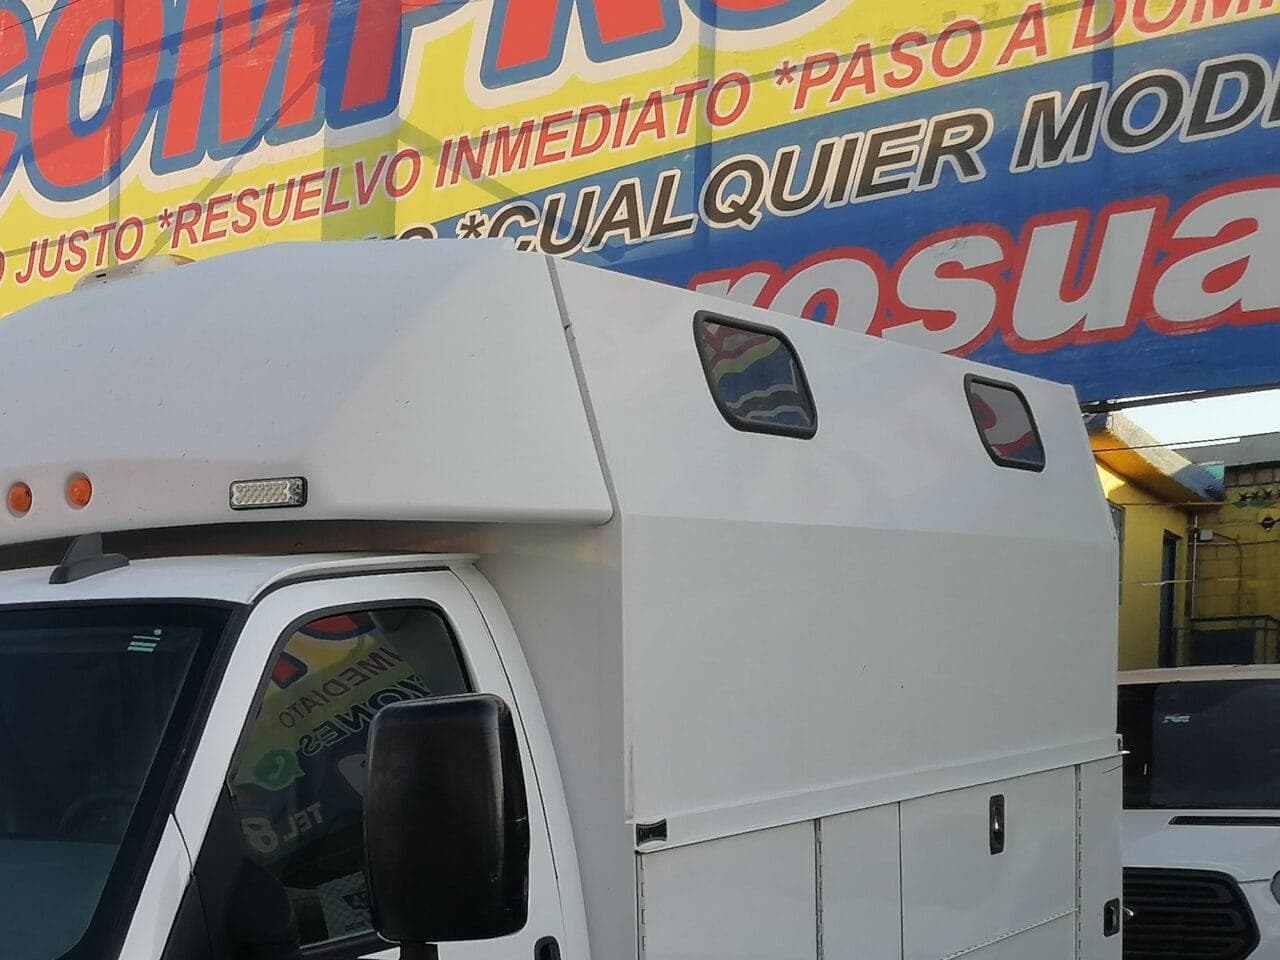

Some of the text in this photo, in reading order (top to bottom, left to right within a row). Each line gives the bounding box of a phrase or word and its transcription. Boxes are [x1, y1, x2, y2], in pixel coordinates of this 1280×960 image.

[15, 216, 144, 284] JUSTO
[436, 72, 751, 186] INMEDIATO
[995, 2, 1049, 66] A
[1012, 56, 1280, 172] MOD
